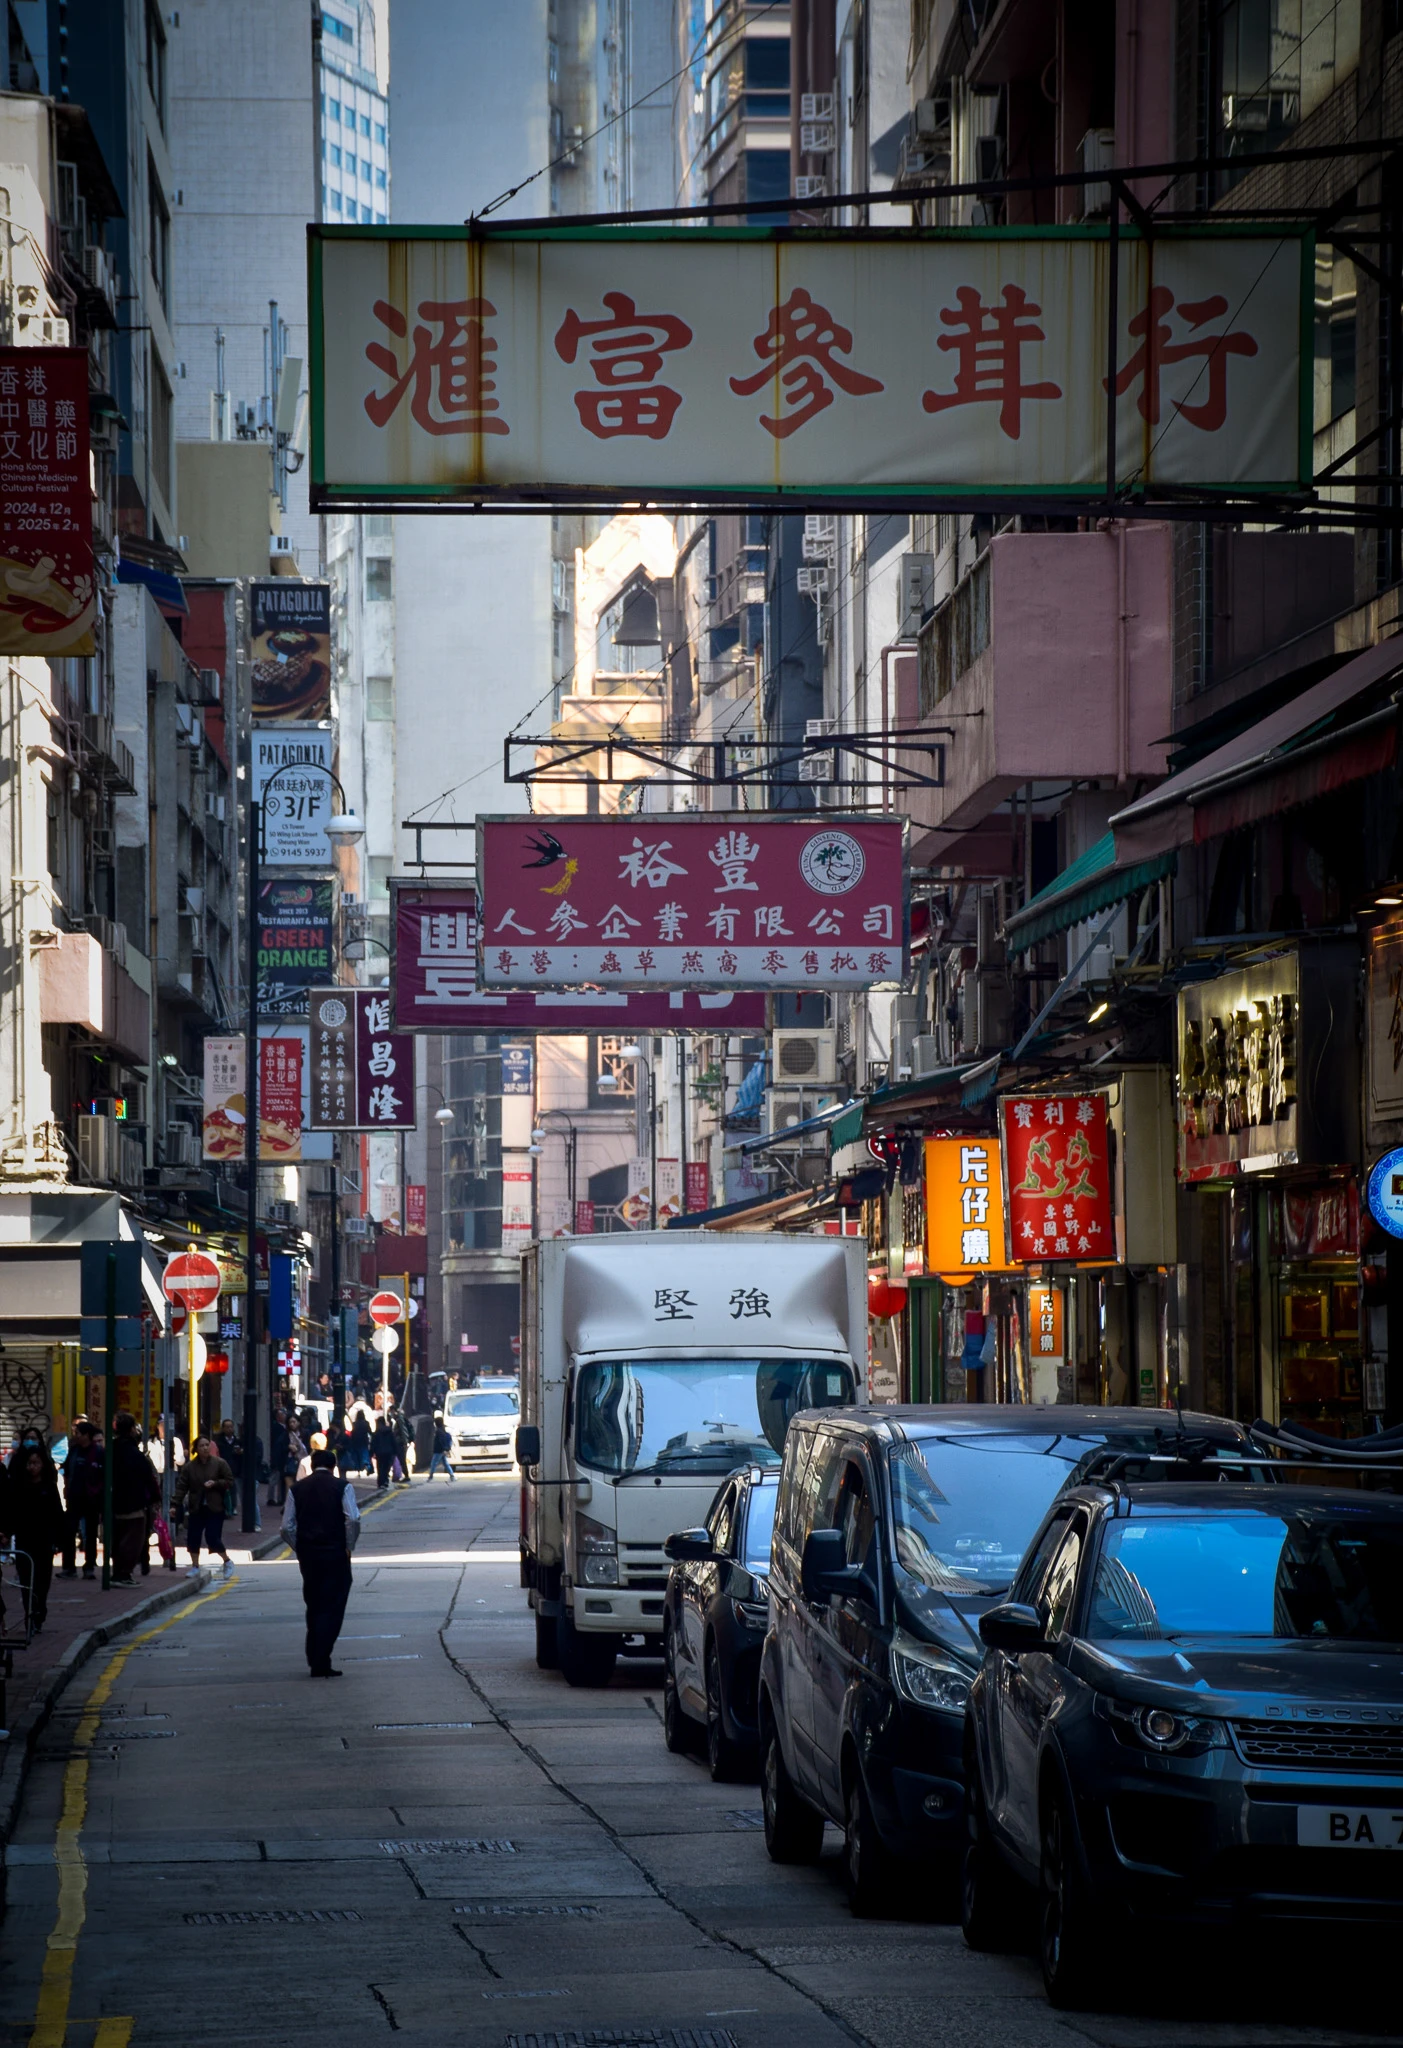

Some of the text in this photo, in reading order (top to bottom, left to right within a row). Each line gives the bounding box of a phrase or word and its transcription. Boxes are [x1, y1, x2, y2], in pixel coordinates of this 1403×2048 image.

[0, 366, 48, 396] 香港
[0, 398, 77, 429] 中醫藥
[0, 431, 78, 460] 文化節
[1, 463, 48, 472] Hong Kong
[1, 474, 78, 482] Chinese Medicine
[1, 484, 69, 492] Culture Festival
[258, 591, 324, 612] PATAGONIA
[260, 744, 325, 765] PATAGONIA
[285, 796, 320, 820] 3/F
[810, 833, 842, 848] GINSENG
[281, 848, 326, 856] 9145 5937
[618, 830, 760, 893] 裕豐
[846, 839, 862, 883] ENTERPRISE
[494, 900, 894, 942] 人參企業有限公司
[262, 928, 324, 948] GREEN
[257, 949, 328, 967] ORANGE
[960, 1146, 989, 1264] 片仔癀
[1330, 1813, 1375, 1843] BA
